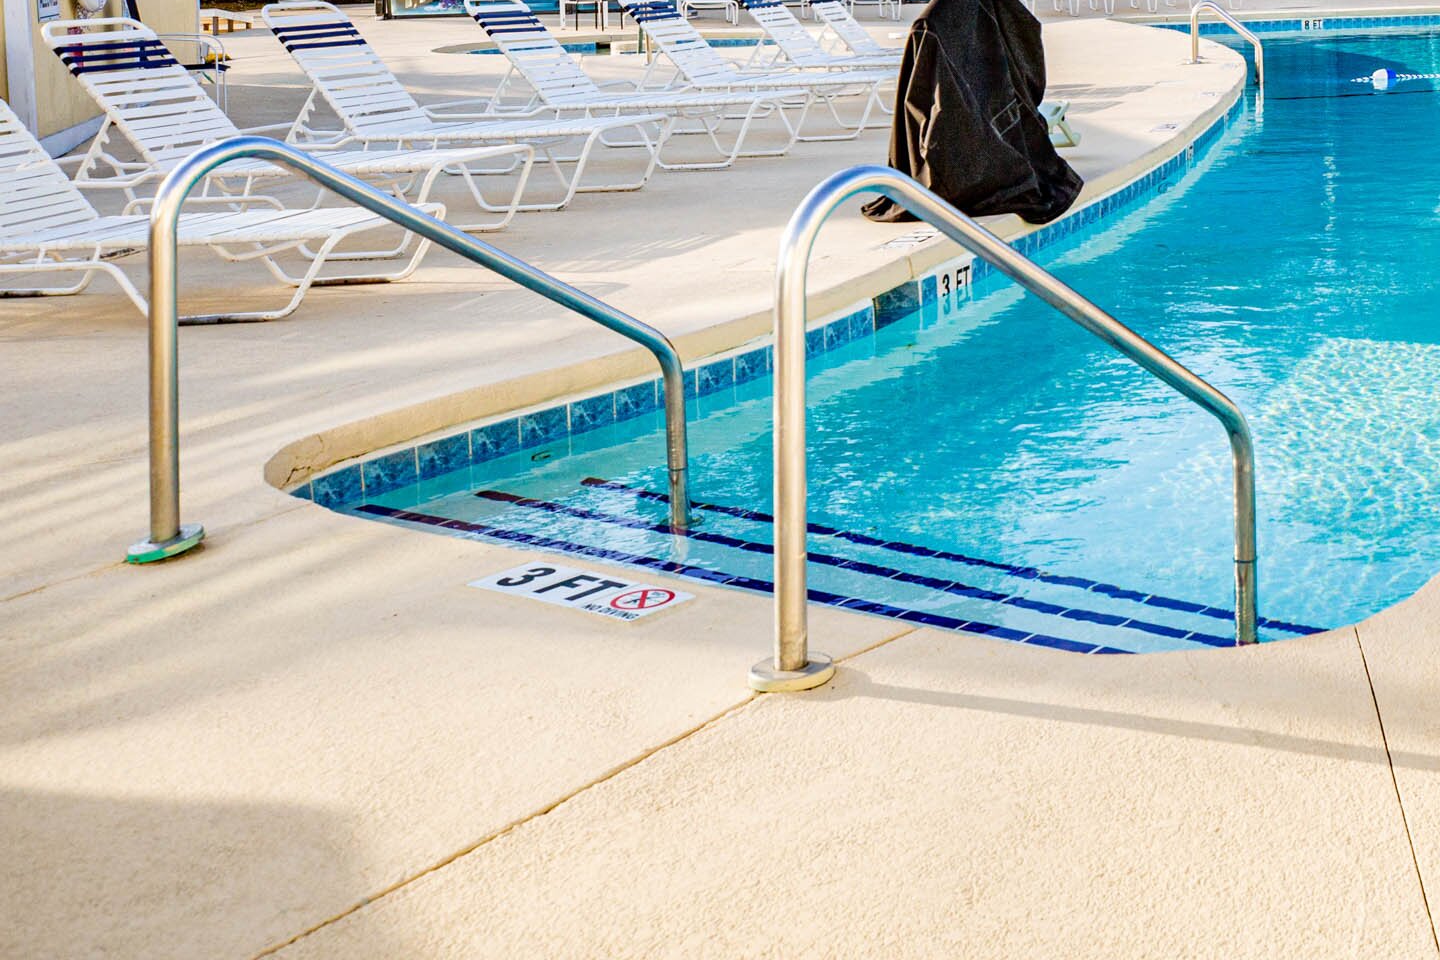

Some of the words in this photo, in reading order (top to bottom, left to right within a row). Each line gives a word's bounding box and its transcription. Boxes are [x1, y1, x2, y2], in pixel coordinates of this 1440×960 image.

[942, 273, 951, 297] 3
[956, 265, 970, 290] FT
[496, 567, 556, 587] 3
[532, 574, 629, 602] FT
